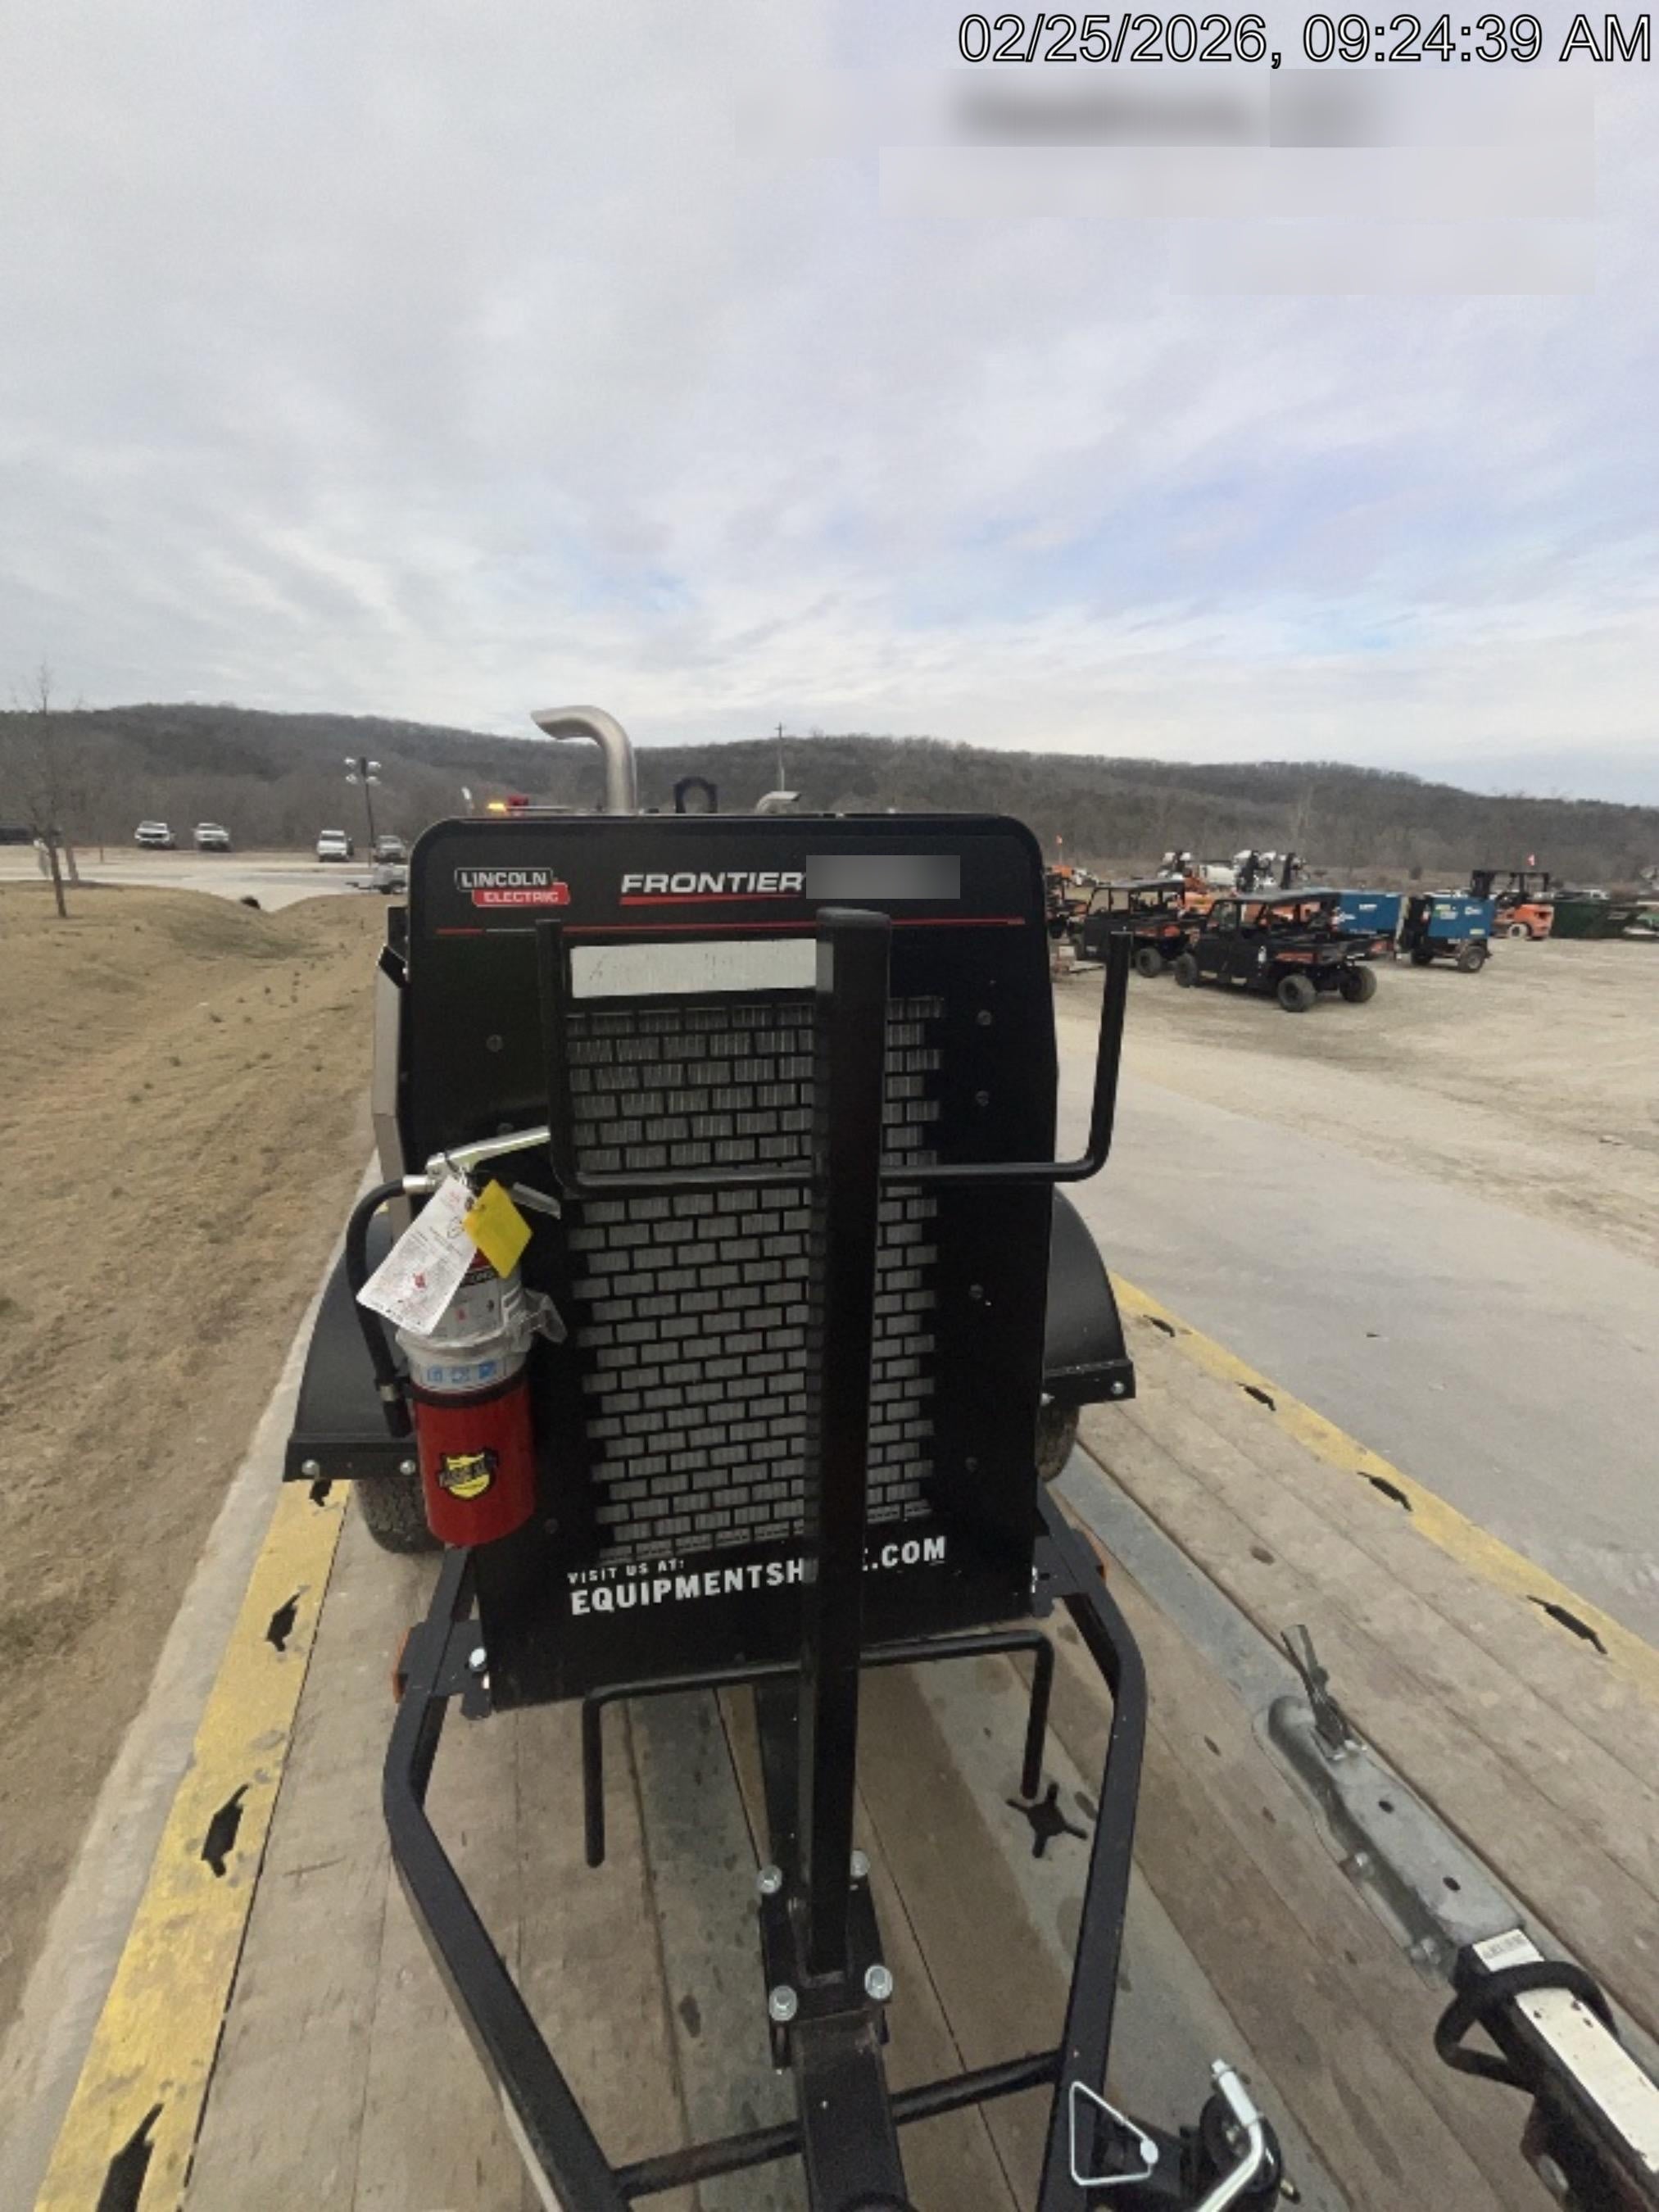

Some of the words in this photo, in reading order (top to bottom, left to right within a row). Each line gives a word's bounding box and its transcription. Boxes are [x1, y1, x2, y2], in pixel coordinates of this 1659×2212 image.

[461, 871, 548, 888] LINCOLN
[620, 872, 803, 893] FRONTIER
[483, 891, 559, 904] ELECTRIC
[567, 1566, 618, 1584] VISIT
[626, 1562, 649, 1577] US
[658, 1558, 685, 1574] AT:
[571, 1534, 946, 1616] EQUIPMENTSH.COM
